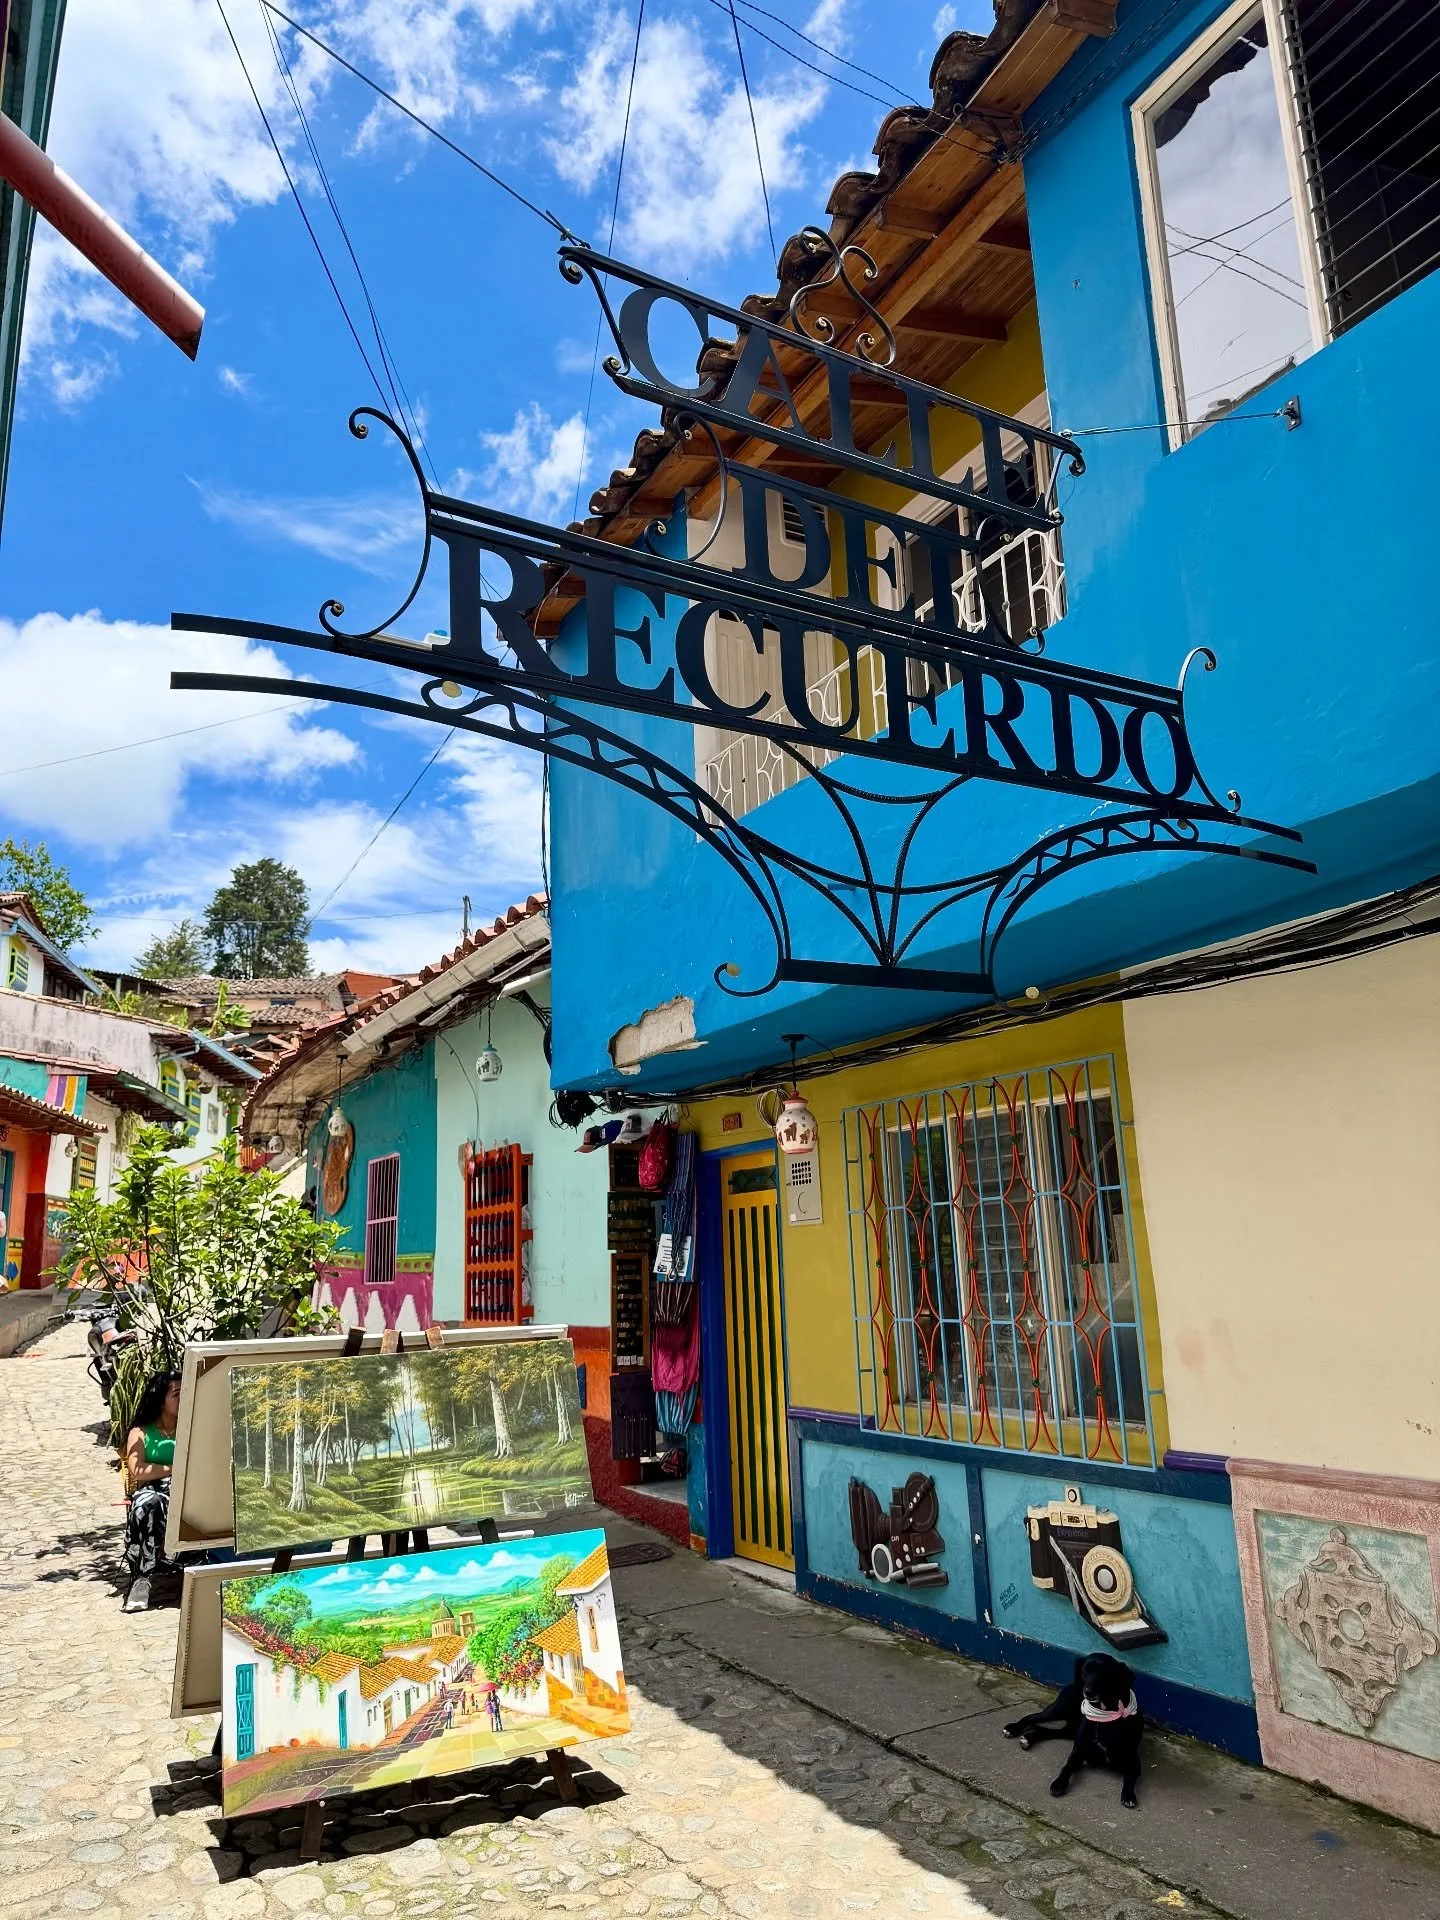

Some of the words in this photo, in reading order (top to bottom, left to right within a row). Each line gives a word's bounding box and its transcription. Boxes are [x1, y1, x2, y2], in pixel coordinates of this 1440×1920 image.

[619, 287, 1046, 508] CALLE
[433, 528, 1196, 801] RECUERDO
[728, 469, 996, 642] DEL
